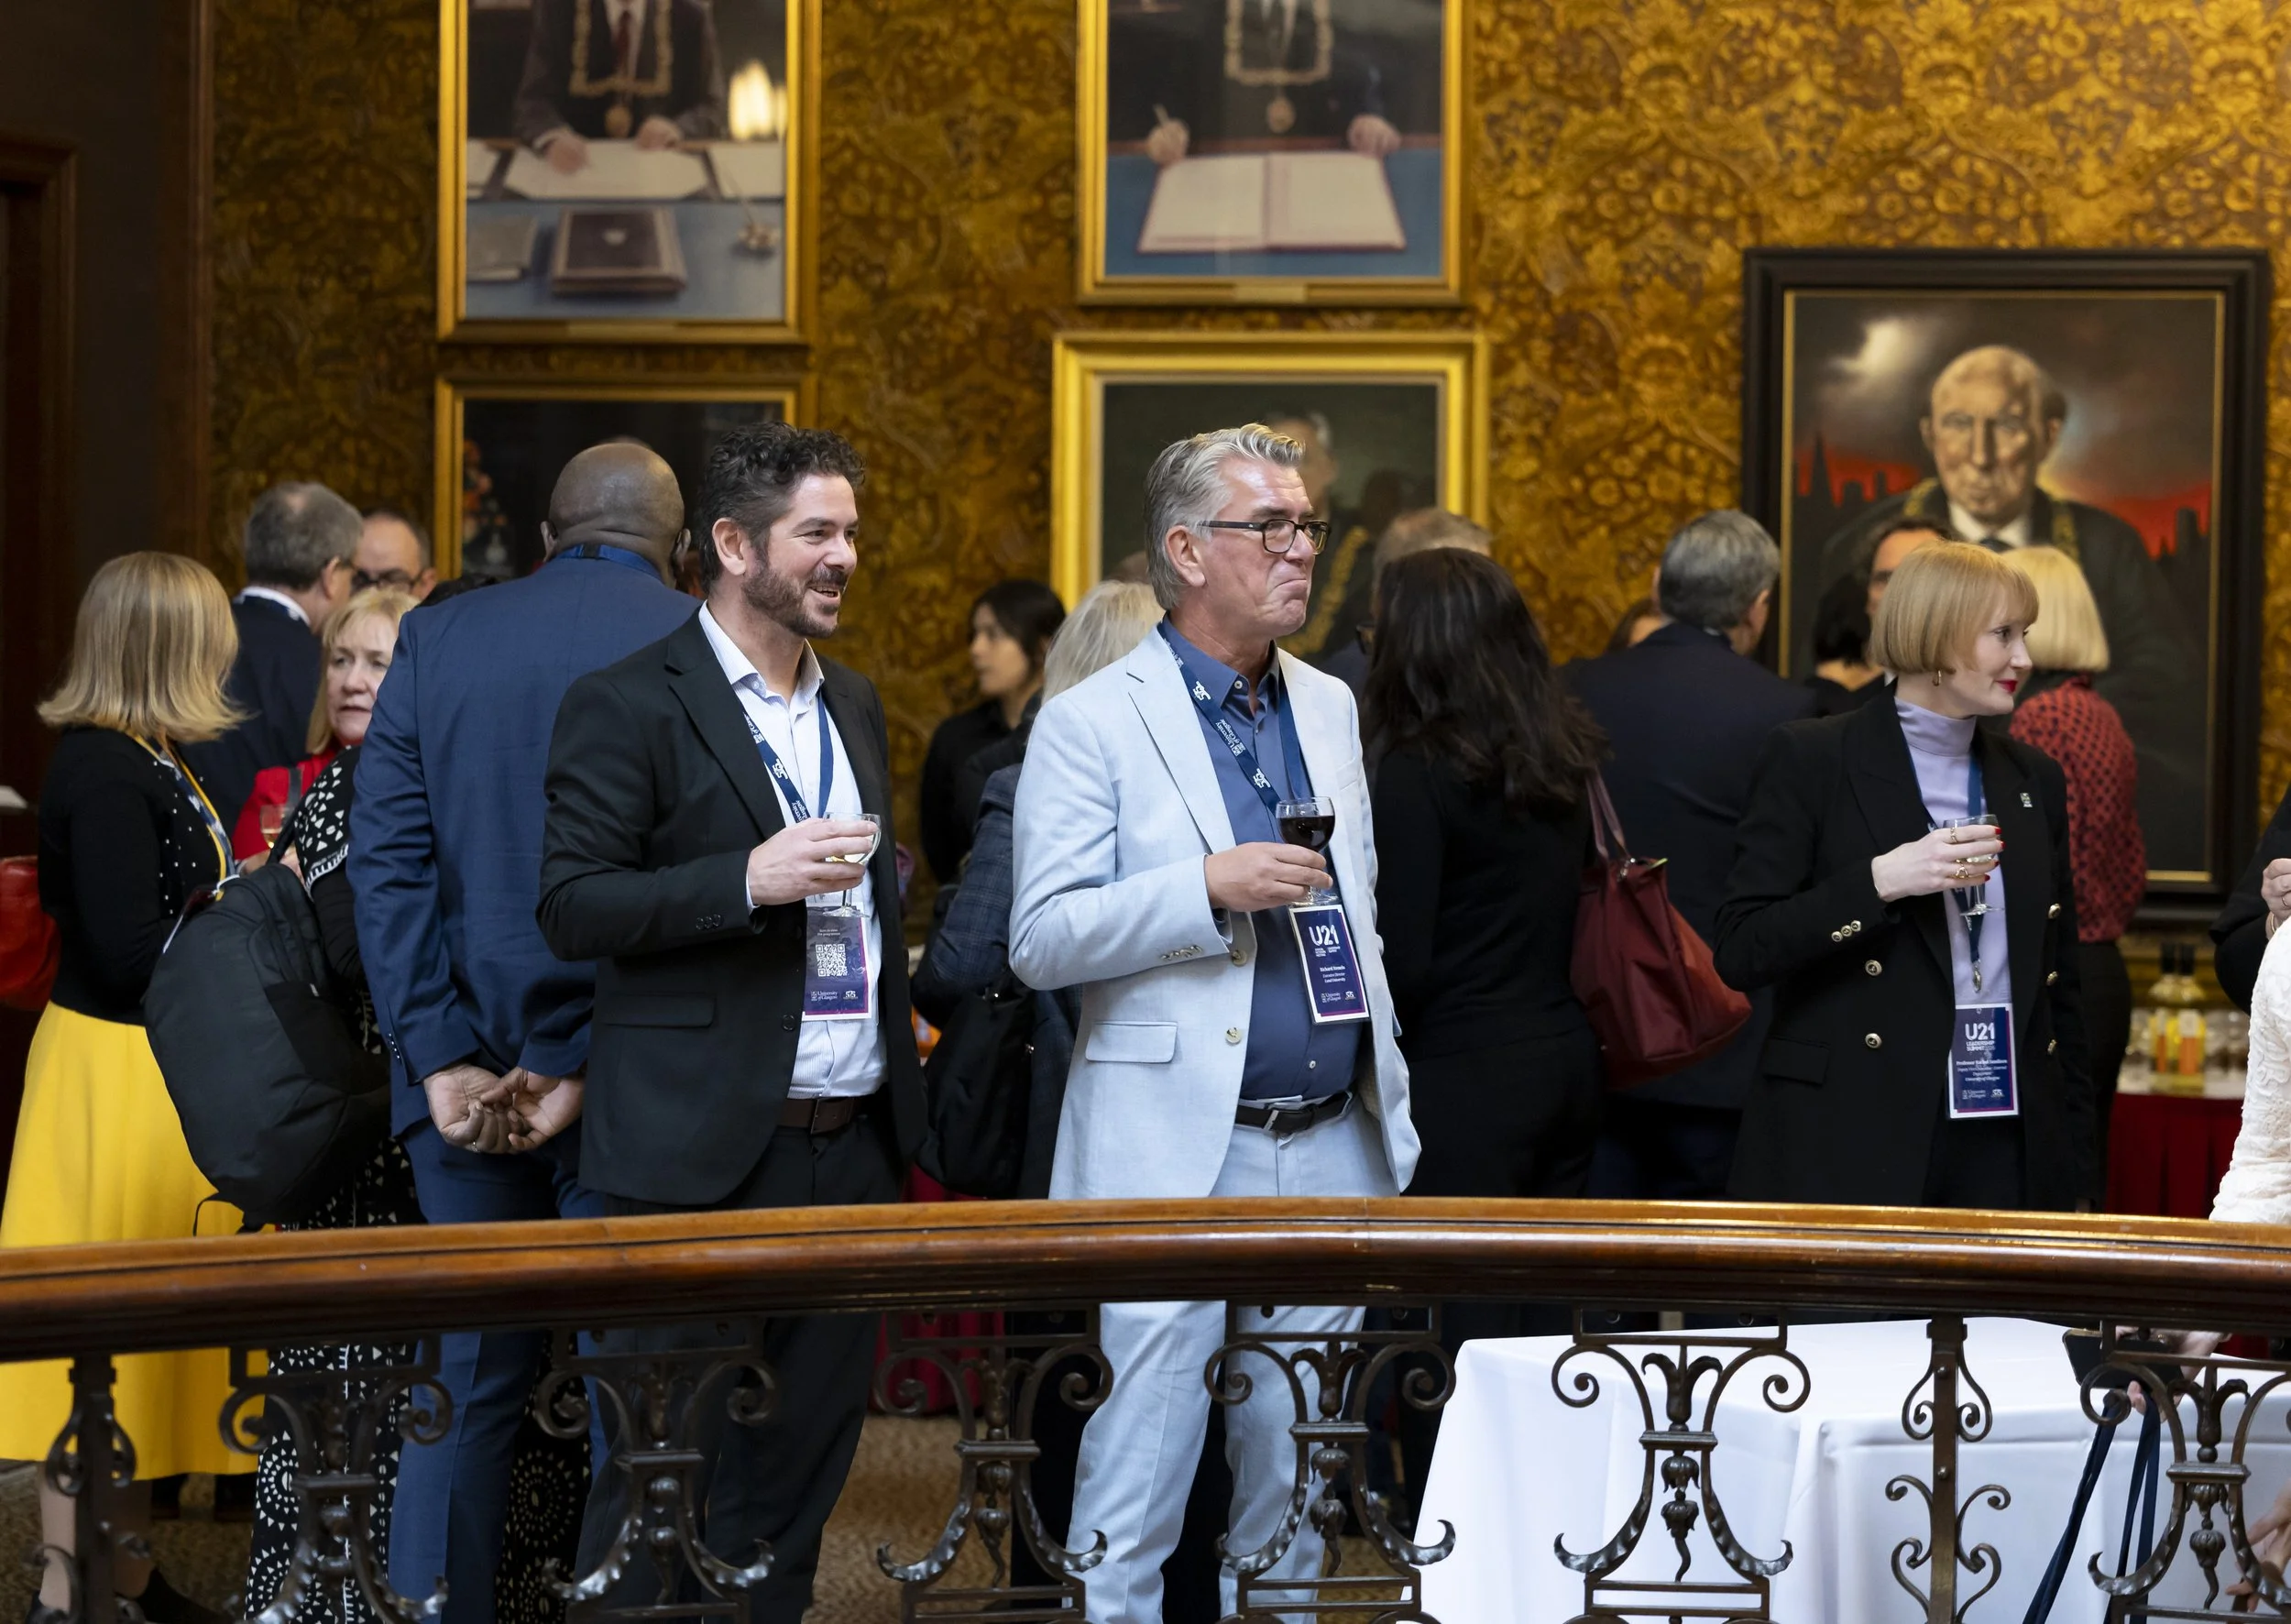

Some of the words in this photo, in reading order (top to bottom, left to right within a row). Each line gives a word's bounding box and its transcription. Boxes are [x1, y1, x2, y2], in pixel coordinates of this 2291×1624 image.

[1214, 721, 1234, 748] University
[1220, 719, 1235, 740] Glasgow
[1309, 924, 1339, 946] U21
[1965, 1022, 1995, 1041] U21
